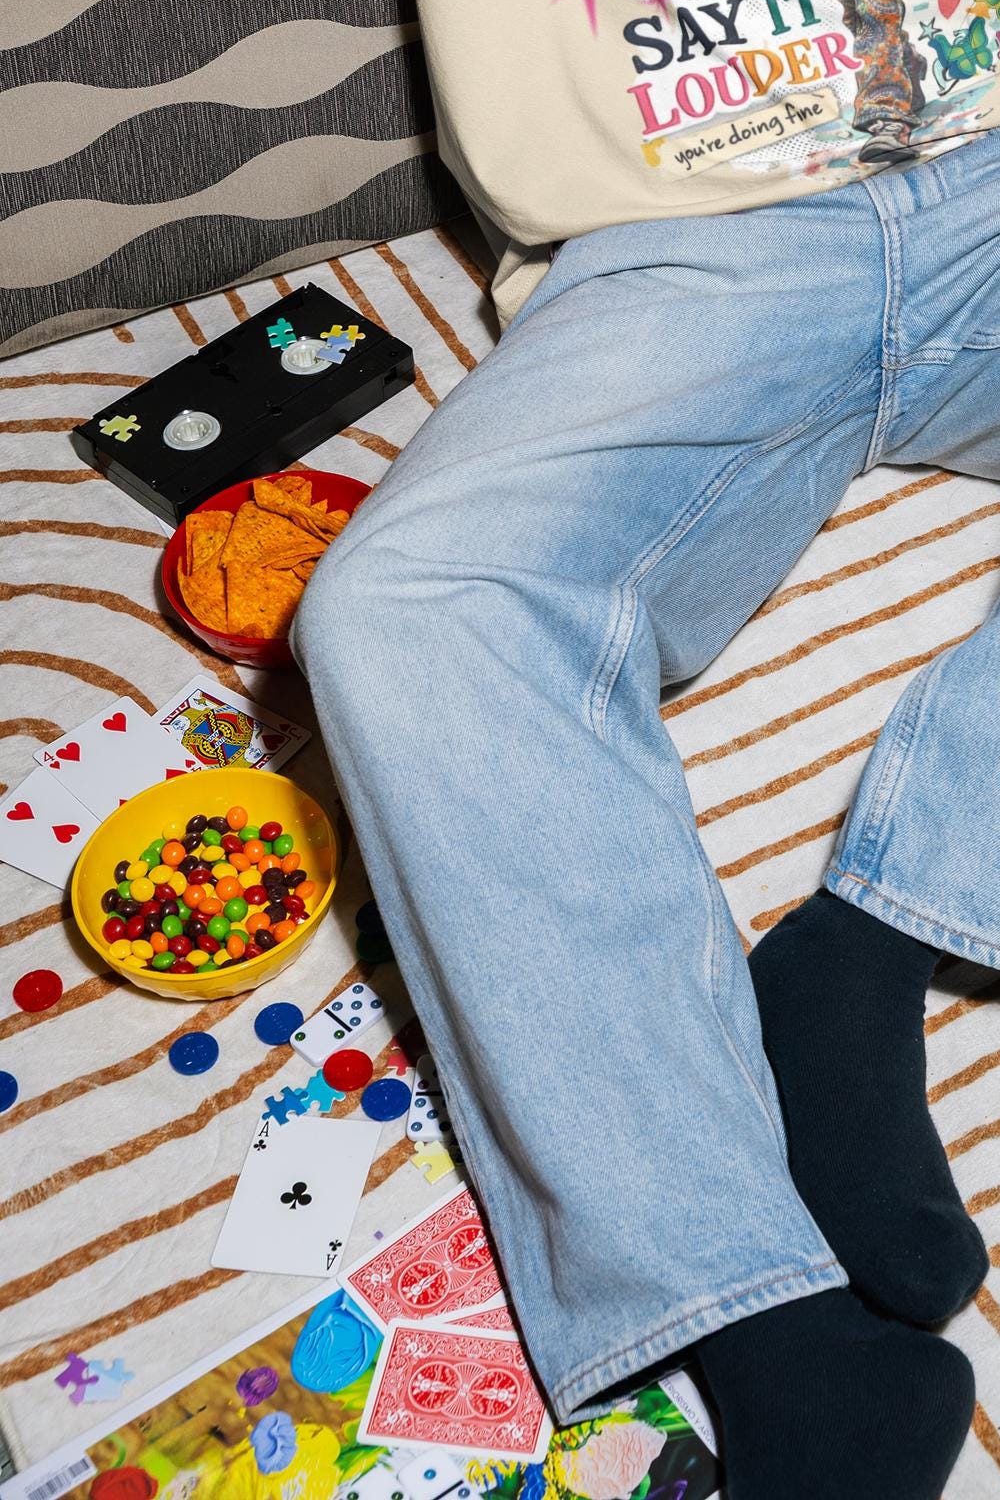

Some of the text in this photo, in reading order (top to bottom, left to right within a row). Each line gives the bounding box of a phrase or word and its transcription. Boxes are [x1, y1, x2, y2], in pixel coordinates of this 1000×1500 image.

[626, 32, 863, 136] LOUDER
[674, 102, 824, 171] you're doing fine
[43, 751, 56, 763] 4
[258, 1120, 270, 1138] A
[325, 1253, 338, 1271] A
